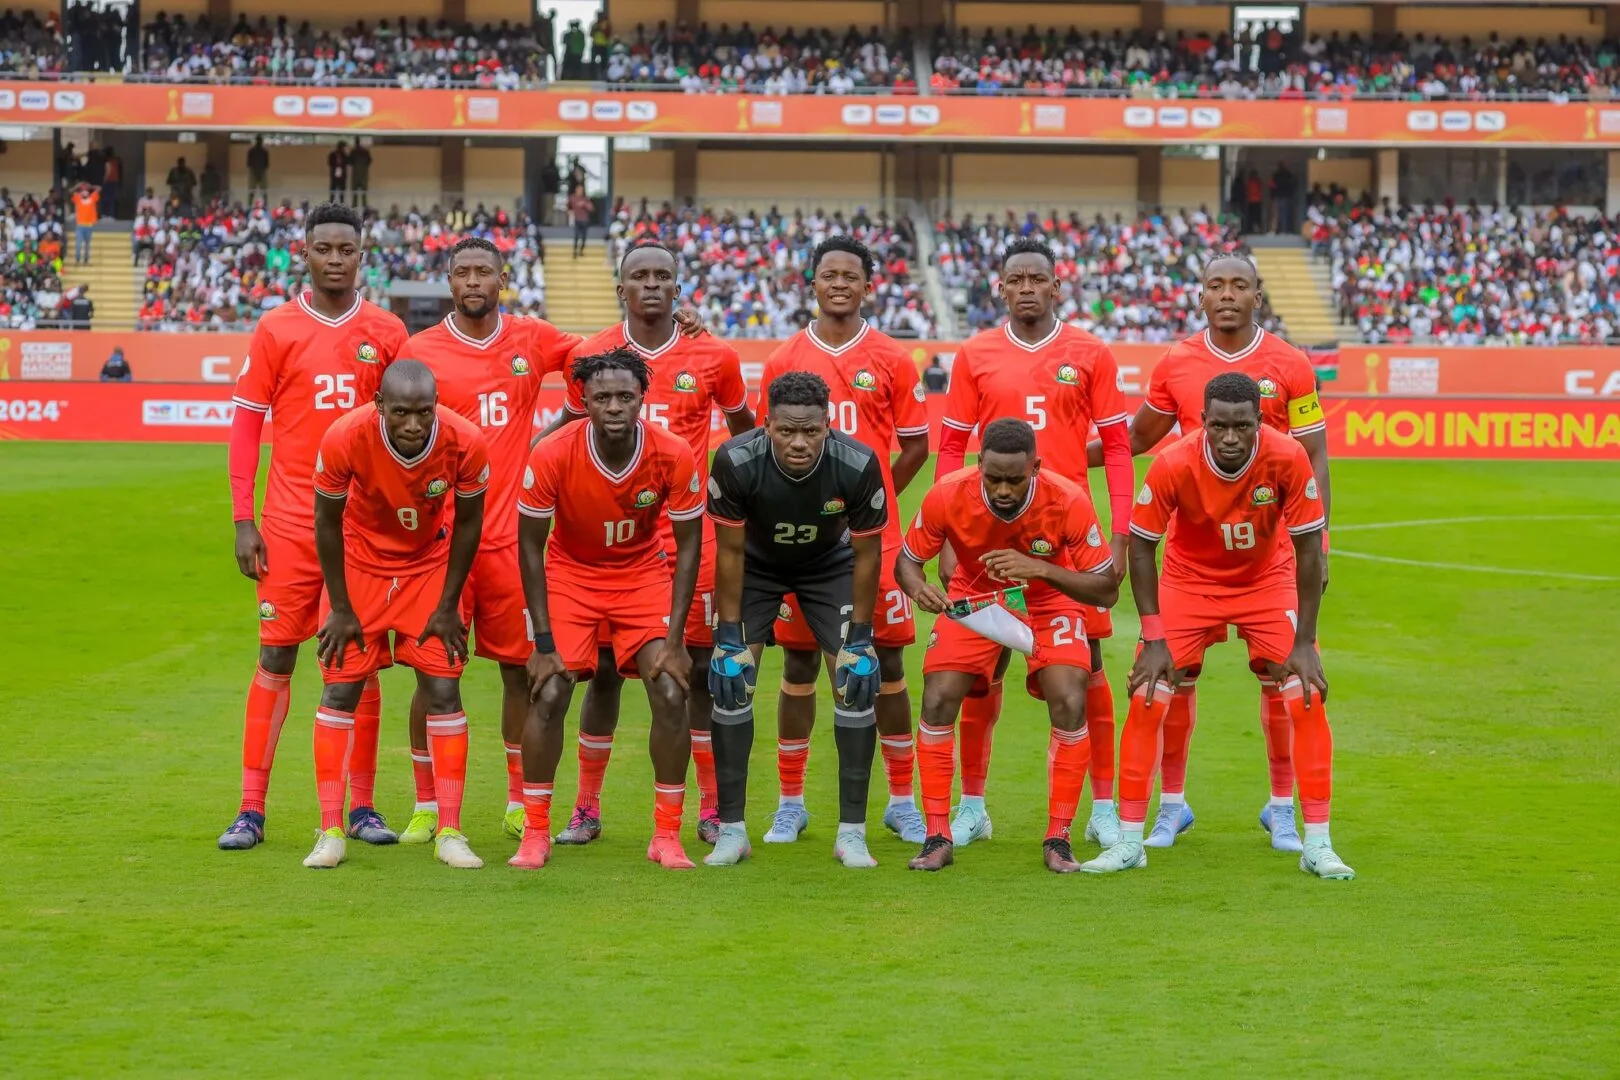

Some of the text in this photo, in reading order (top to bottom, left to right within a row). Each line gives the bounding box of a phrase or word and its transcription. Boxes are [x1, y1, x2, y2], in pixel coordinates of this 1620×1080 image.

[314, 373, 356, 410] 25
[477, 391, 509, 427] 16
[1026, 396, 1047, 431] 5
[1346, 411, 1436, 447] MOI
[604, 519, 635, 547] 10
[774, 522, 818, 544] 23
[1220, 522, 1256, 551] 19
[1050, 615, 1089, 649] 24
